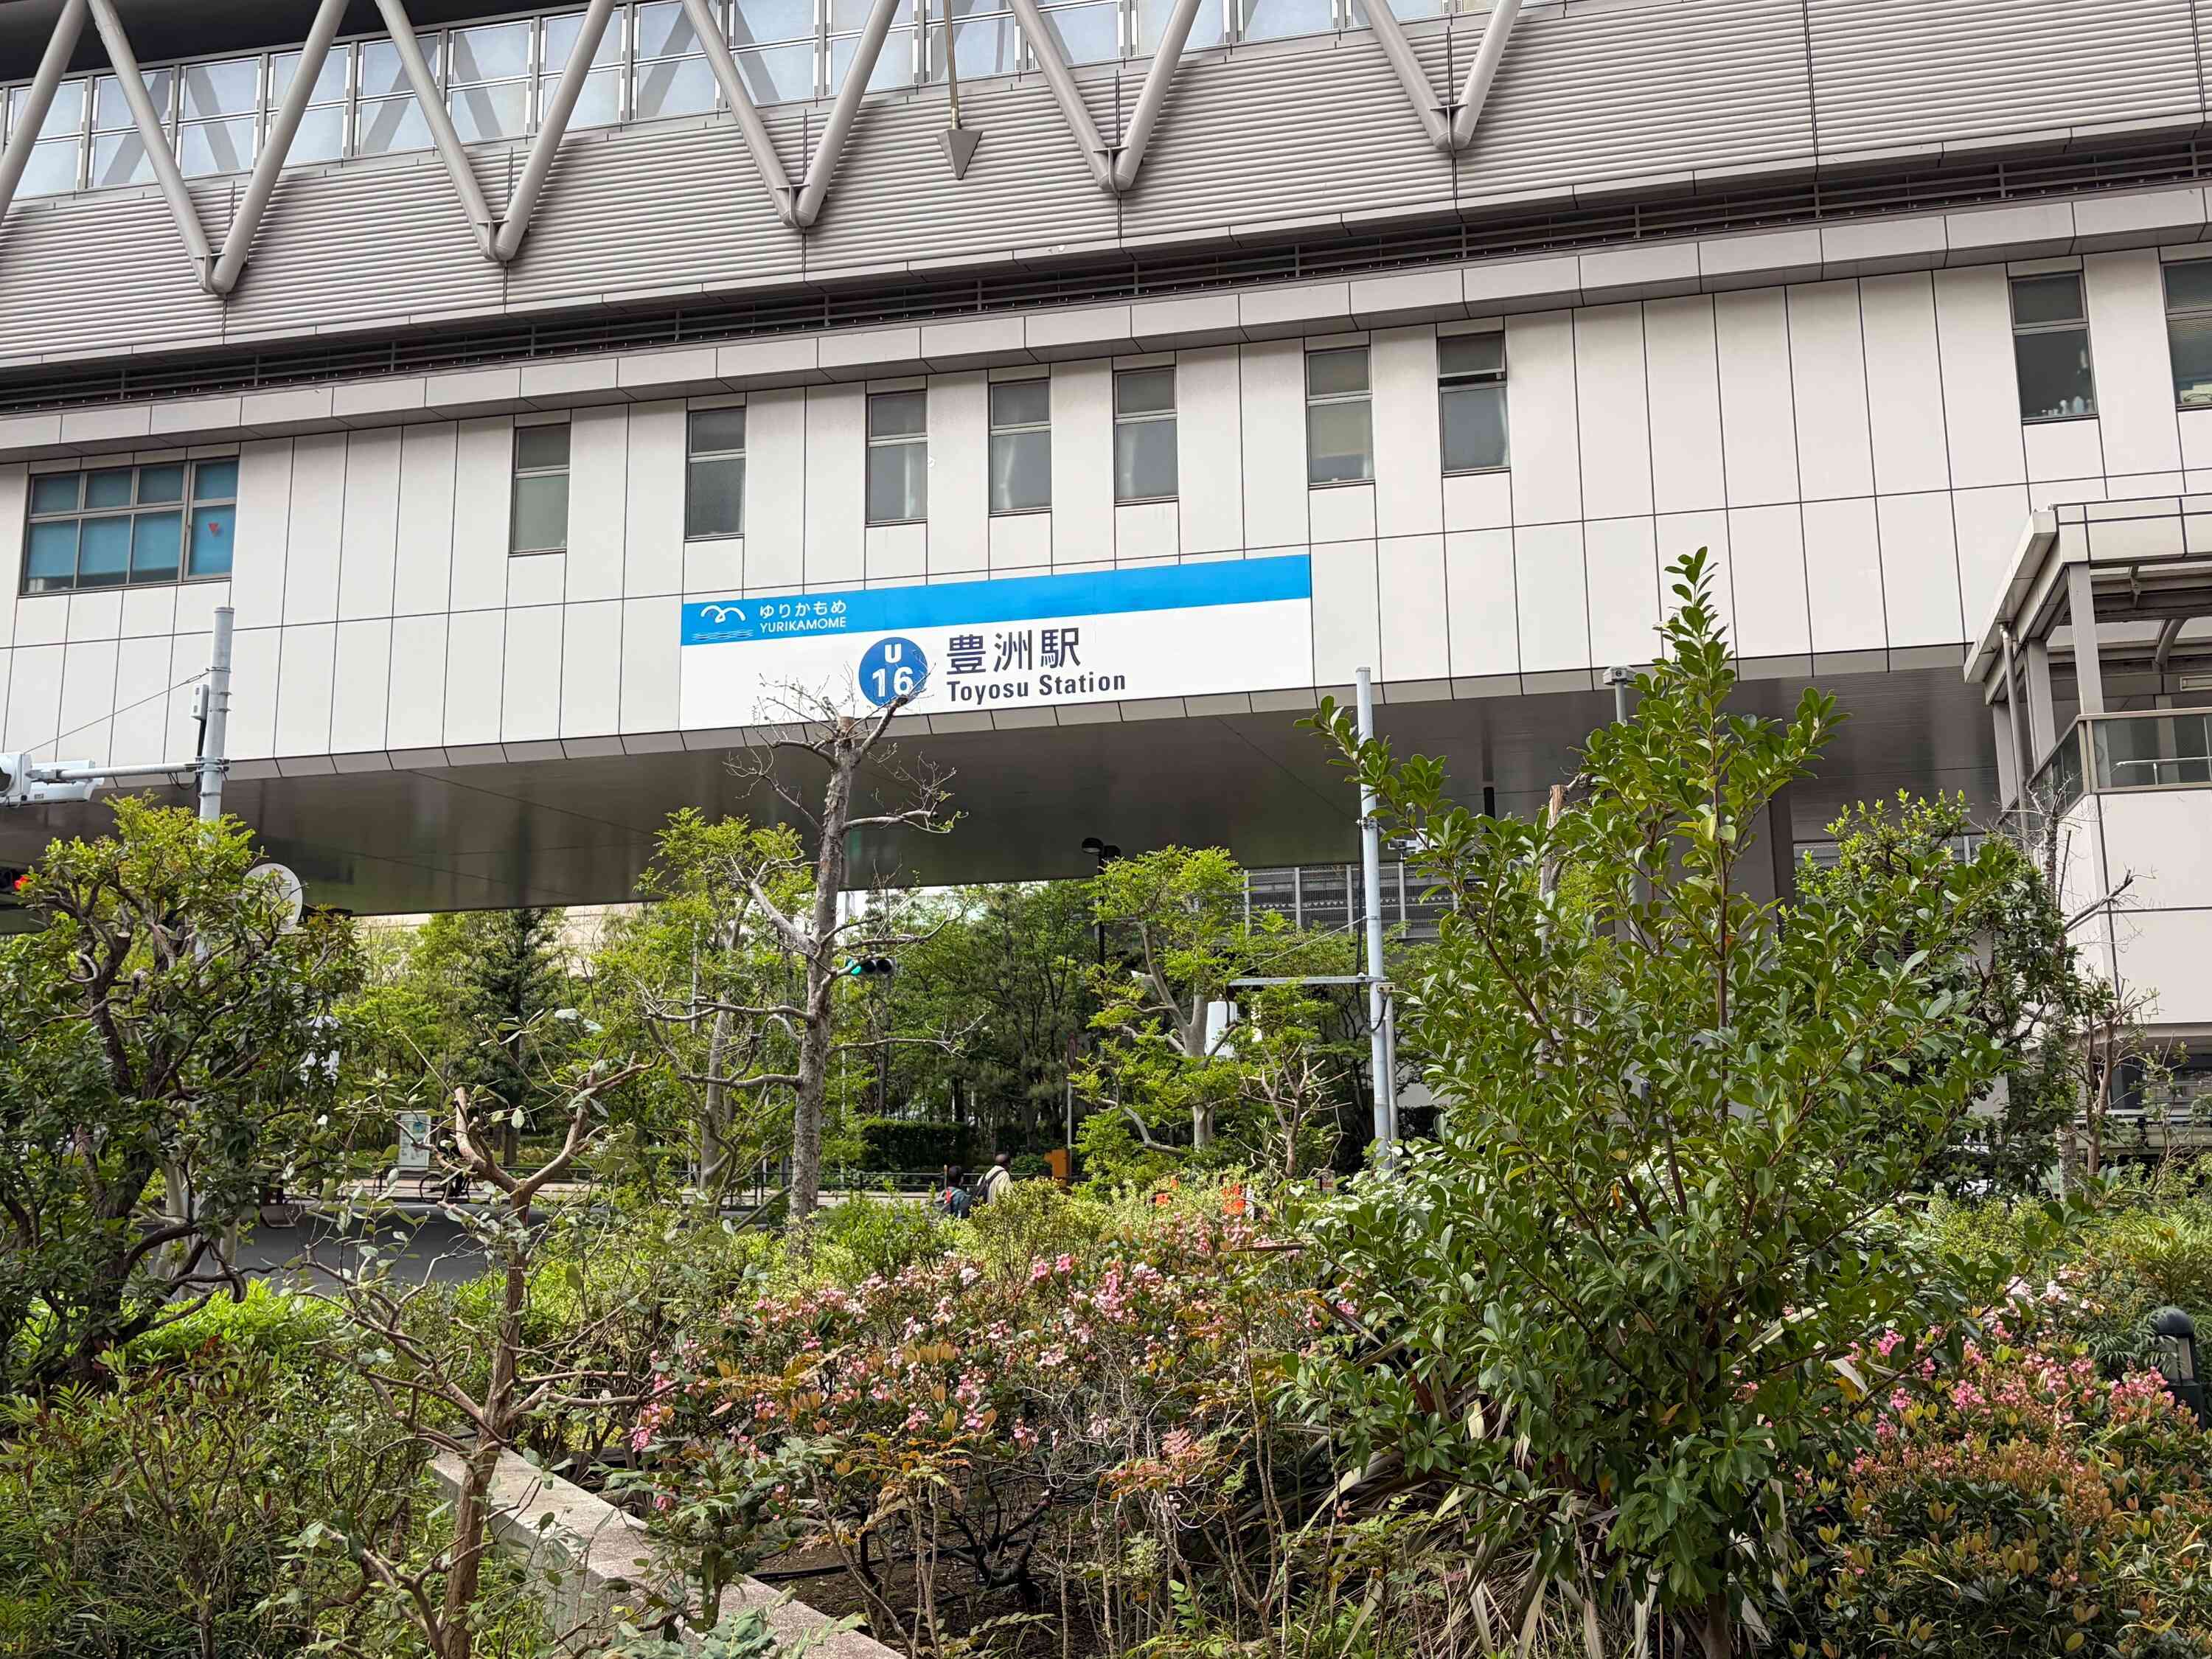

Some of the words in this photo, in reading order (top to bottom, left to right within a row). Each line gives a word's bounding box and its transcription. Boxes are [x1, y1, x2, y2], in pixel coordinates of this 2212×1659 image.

[759, 599, 846, 619] ゆりかもめ
[759, 616, 846, 633] YURIKAMOME
[885, 643, 902, 663] U
[947, 627, 1081, 675] 豊洲駅
[872, 667, 914, 698] 16
[947, 681, 1029, 706] Toyosu
[1039, 672, 1126, 696] Station
